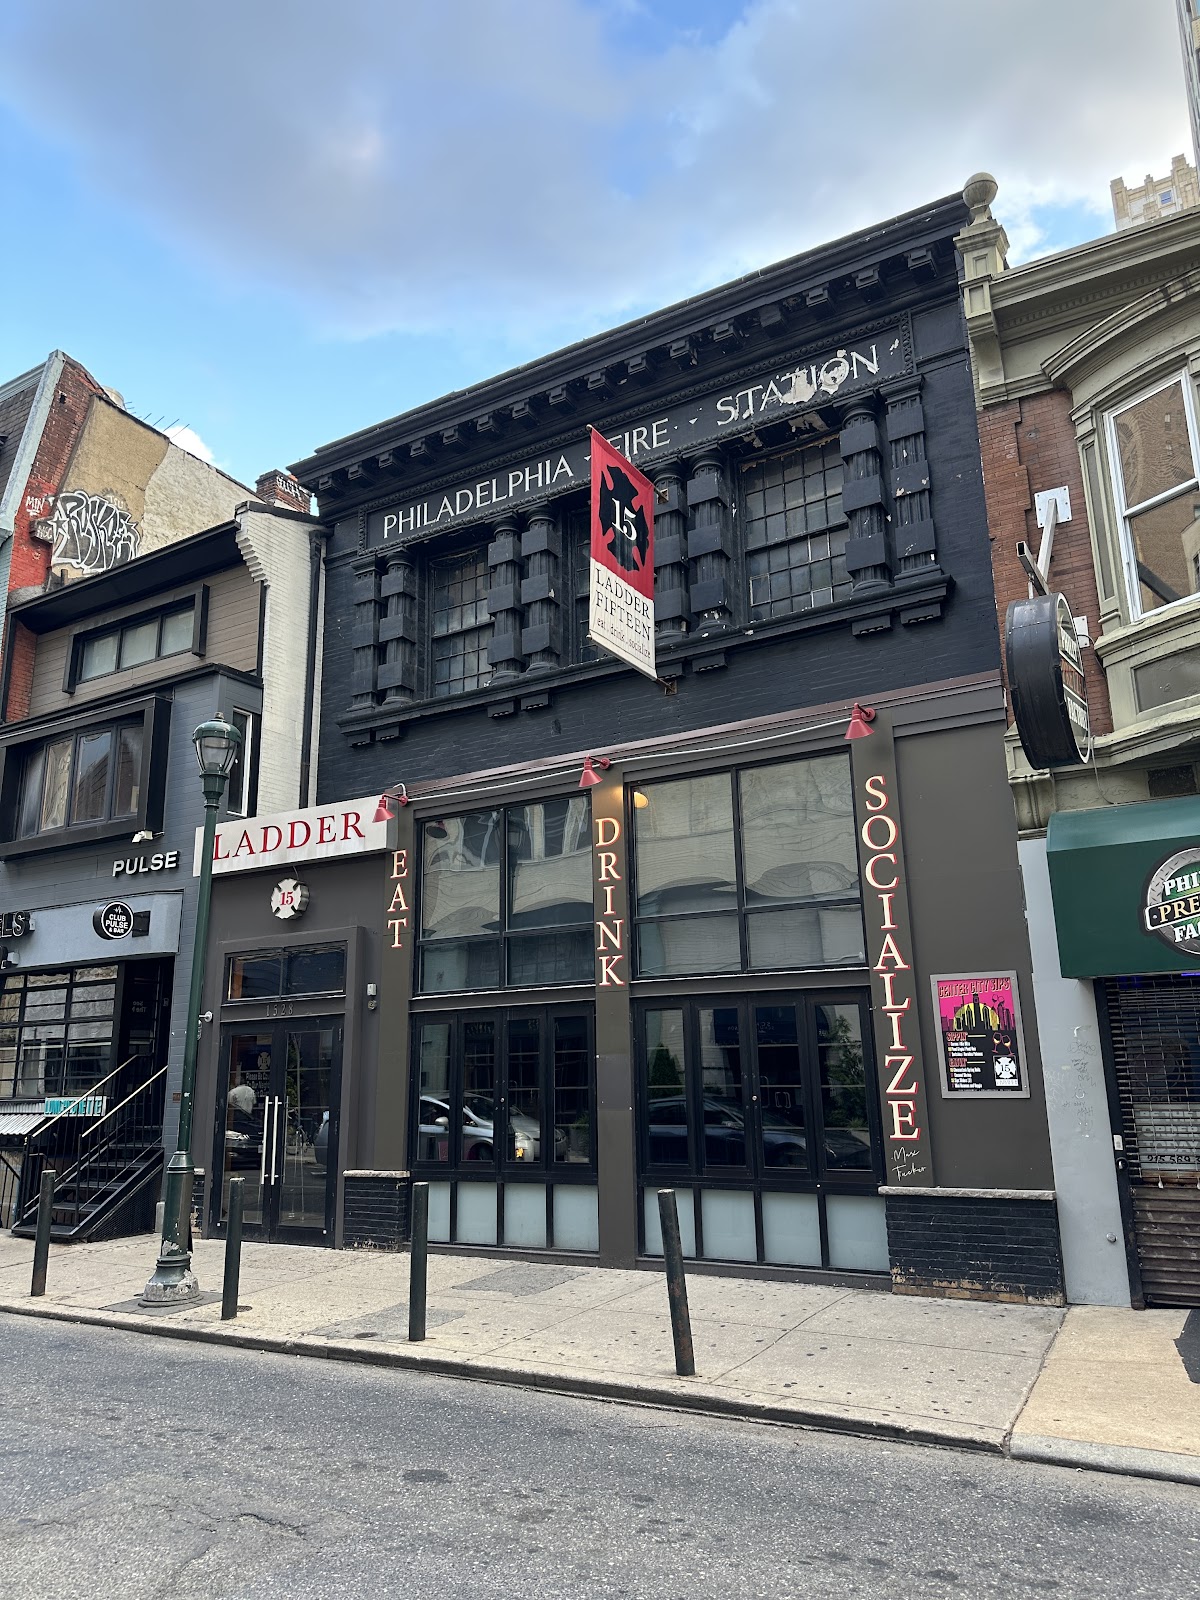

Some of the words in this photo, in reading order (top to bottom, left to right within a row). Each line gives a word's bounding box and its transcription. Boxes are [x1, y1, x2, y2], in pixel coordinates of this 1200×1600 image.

[383, 455, 574, 538] PHILADELPHIA
[611, 497, 637, 540] 15
[595, 567, 650, 620] LADDER
[595, 589, 650, 641] FIFTEEN
[213, 811, 365, 861] LADDER
[112, 850, 180, 878] PULSE
[1164, 871, 1200, 896] PHI
[281, 891, 294, 906] 15
[387, 850, 409, 948] EAT
[596, 817, 625, 986] DRINK
[105, 919, 129, 930] PULSE
[108, 913, 126, 922] CLUB
[1174, 924, 1200, 943] FA
[861, 775, 921, 1141] SOCIALIZE
[971, 980, 989, 994] CITY
[991, 978, 1010, 992] SIPS
[266, 1003, 294, 1017] 1528
[1000, 1064, 1010, 1072] 15
